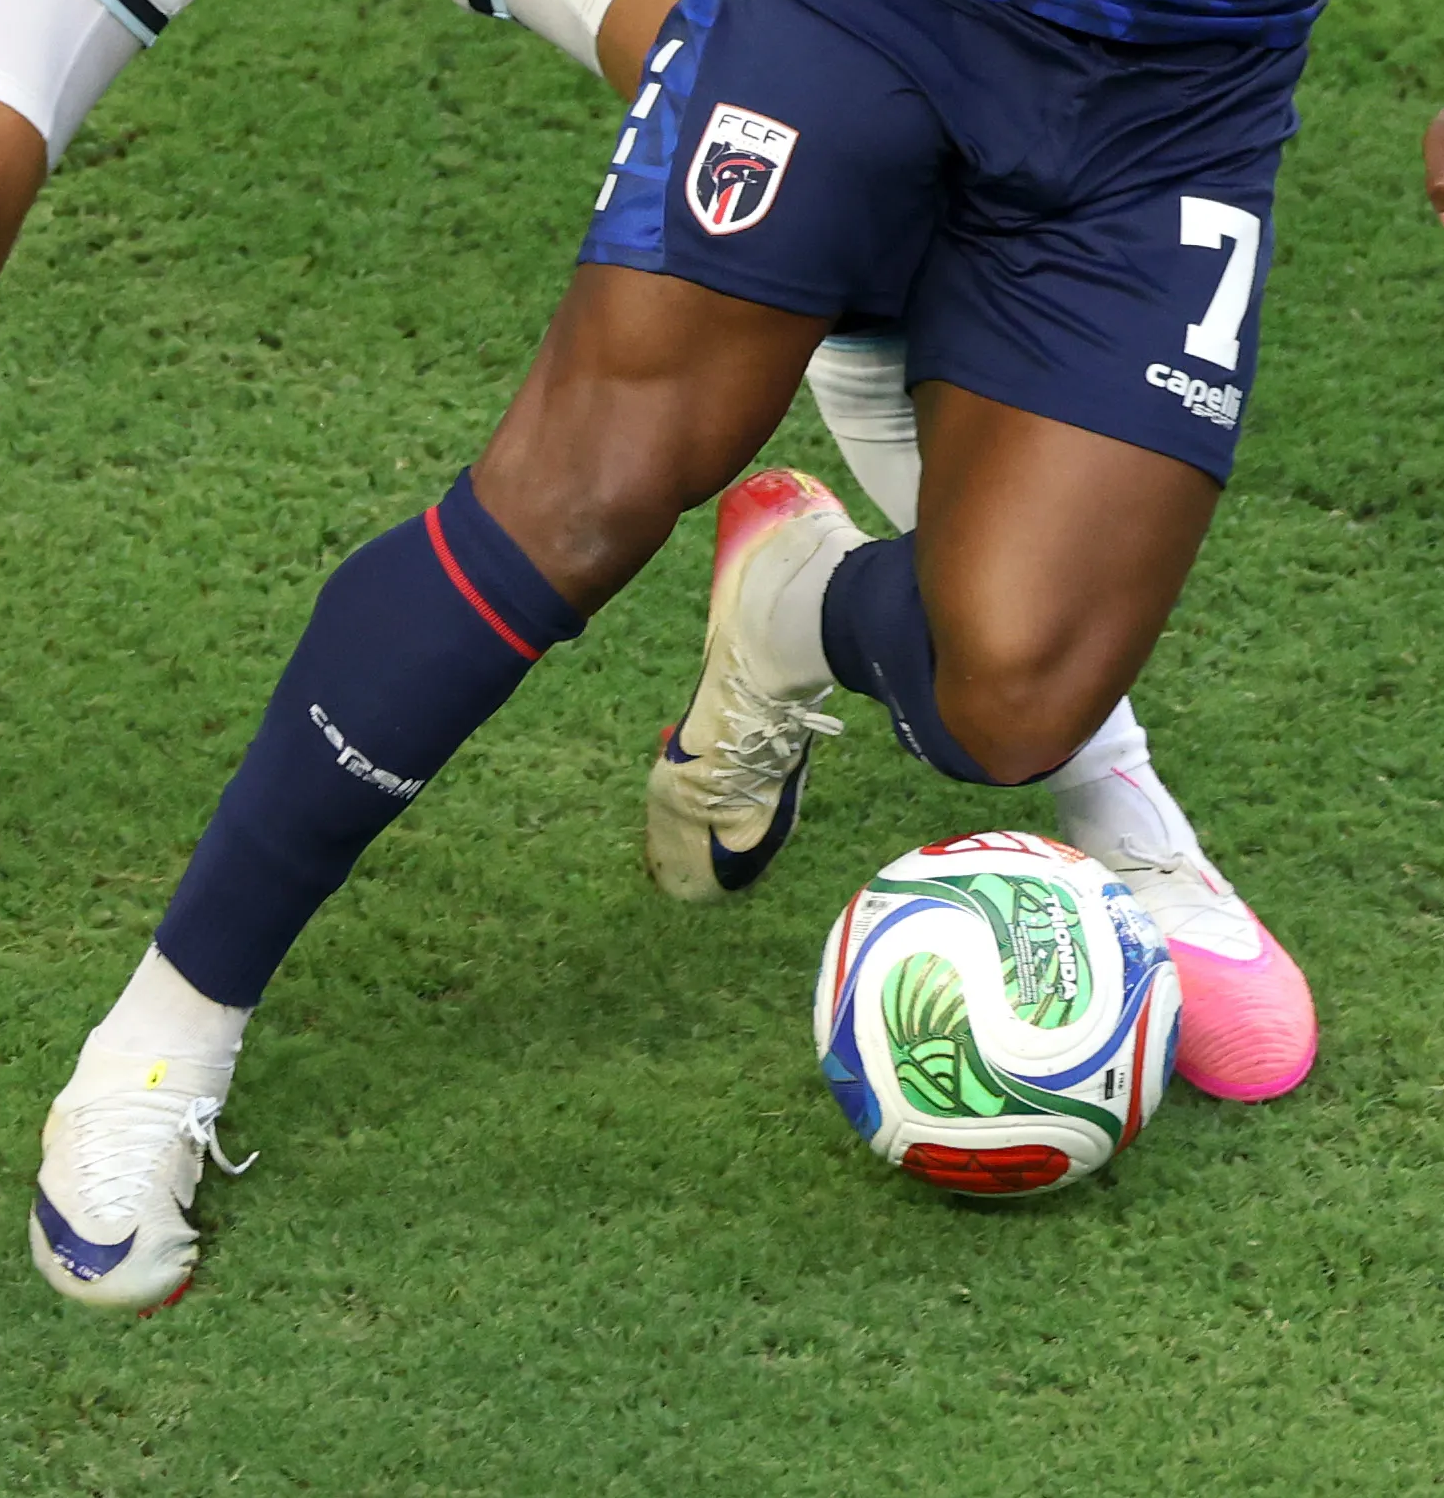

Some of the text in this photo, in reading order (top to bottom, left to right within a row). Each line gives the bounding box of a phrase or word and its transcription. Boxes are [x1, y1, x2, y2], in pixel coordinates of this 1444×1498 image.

[718, 114, 788, 144] FCF
[1179, 196, 1261, 372] 7
[1043, 893, 1078, 1001] TRIONDA
